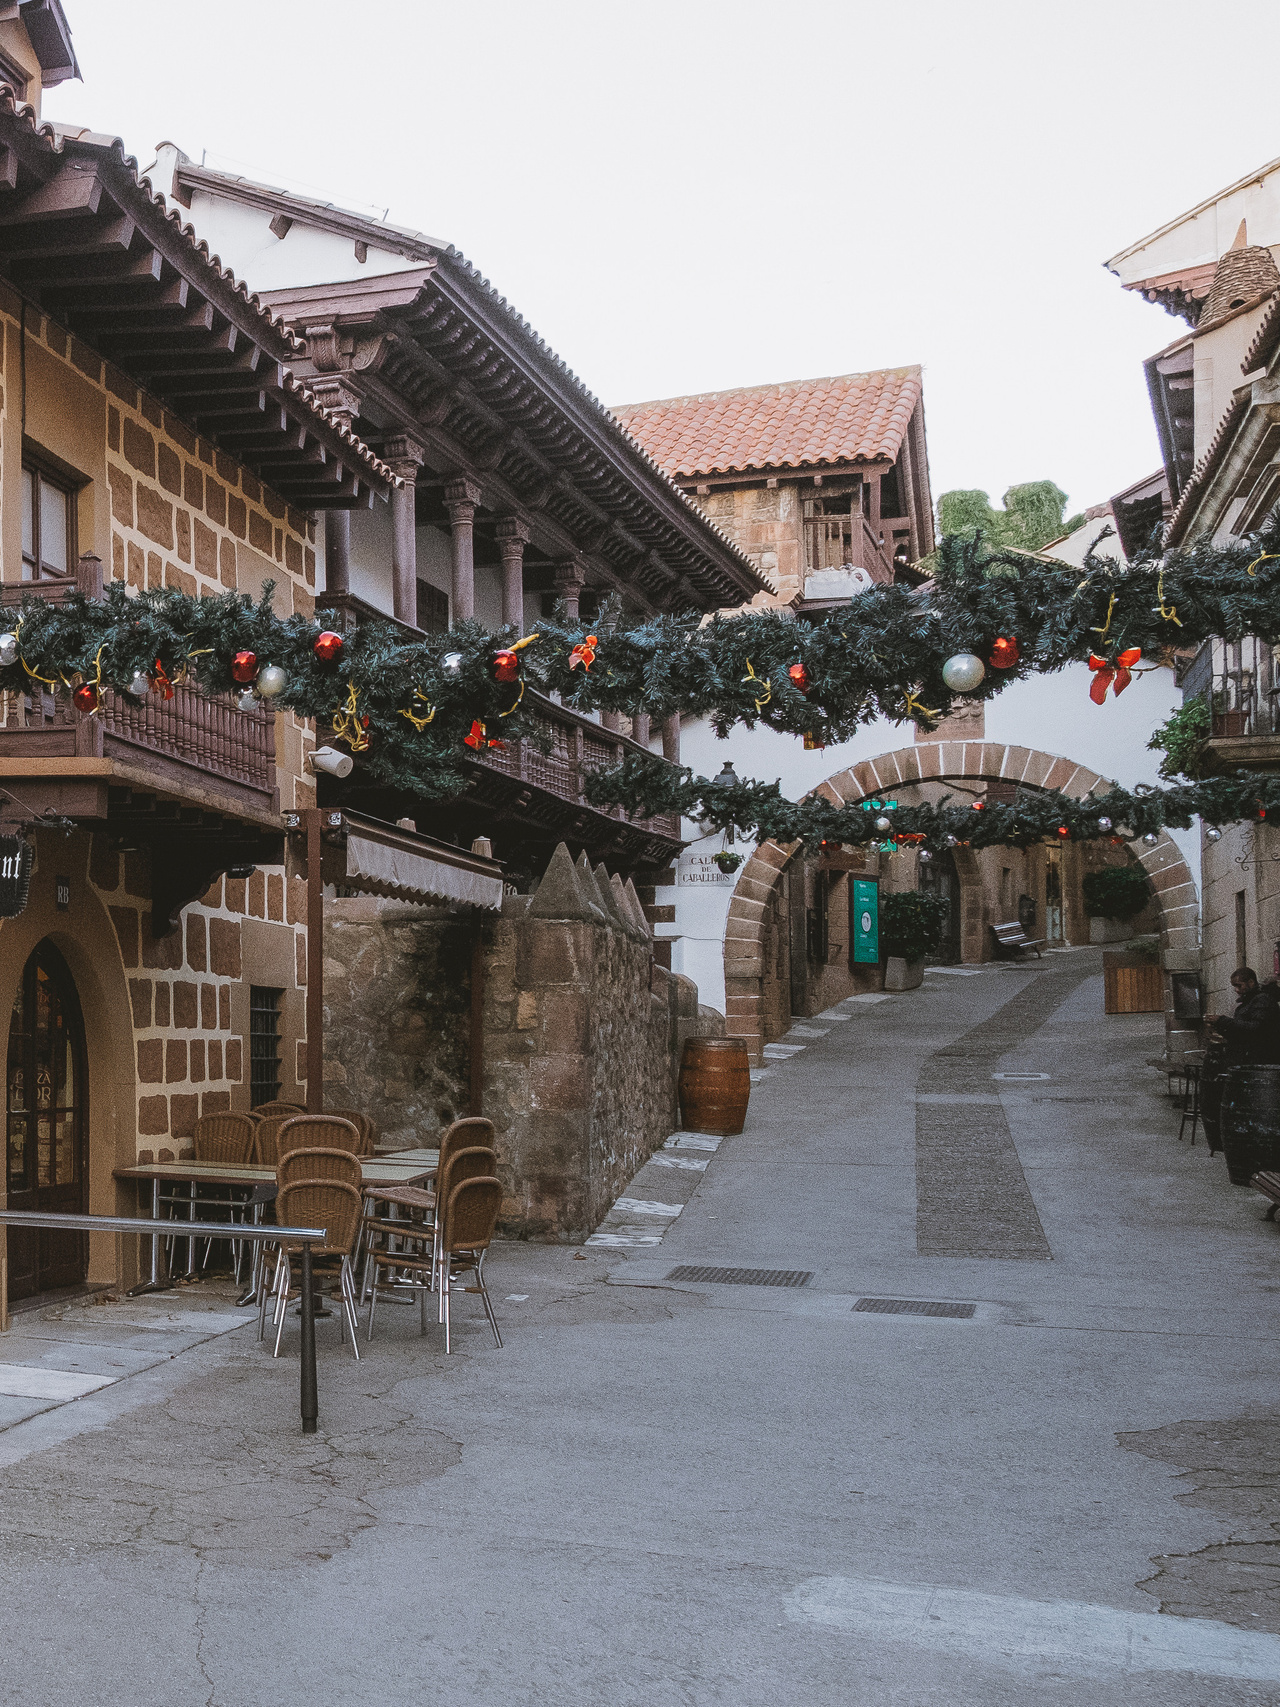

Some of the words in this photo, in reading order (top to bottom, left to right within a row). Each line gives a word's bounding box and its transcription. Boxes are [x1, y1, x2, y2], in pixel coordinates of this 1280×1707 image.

[690, 856, 719, 865] CALL
[682, 873, 730, 882] CABALLEROS
[57, 885, 69, 904] RB
[15, 1068, 51, 1084] PZA
